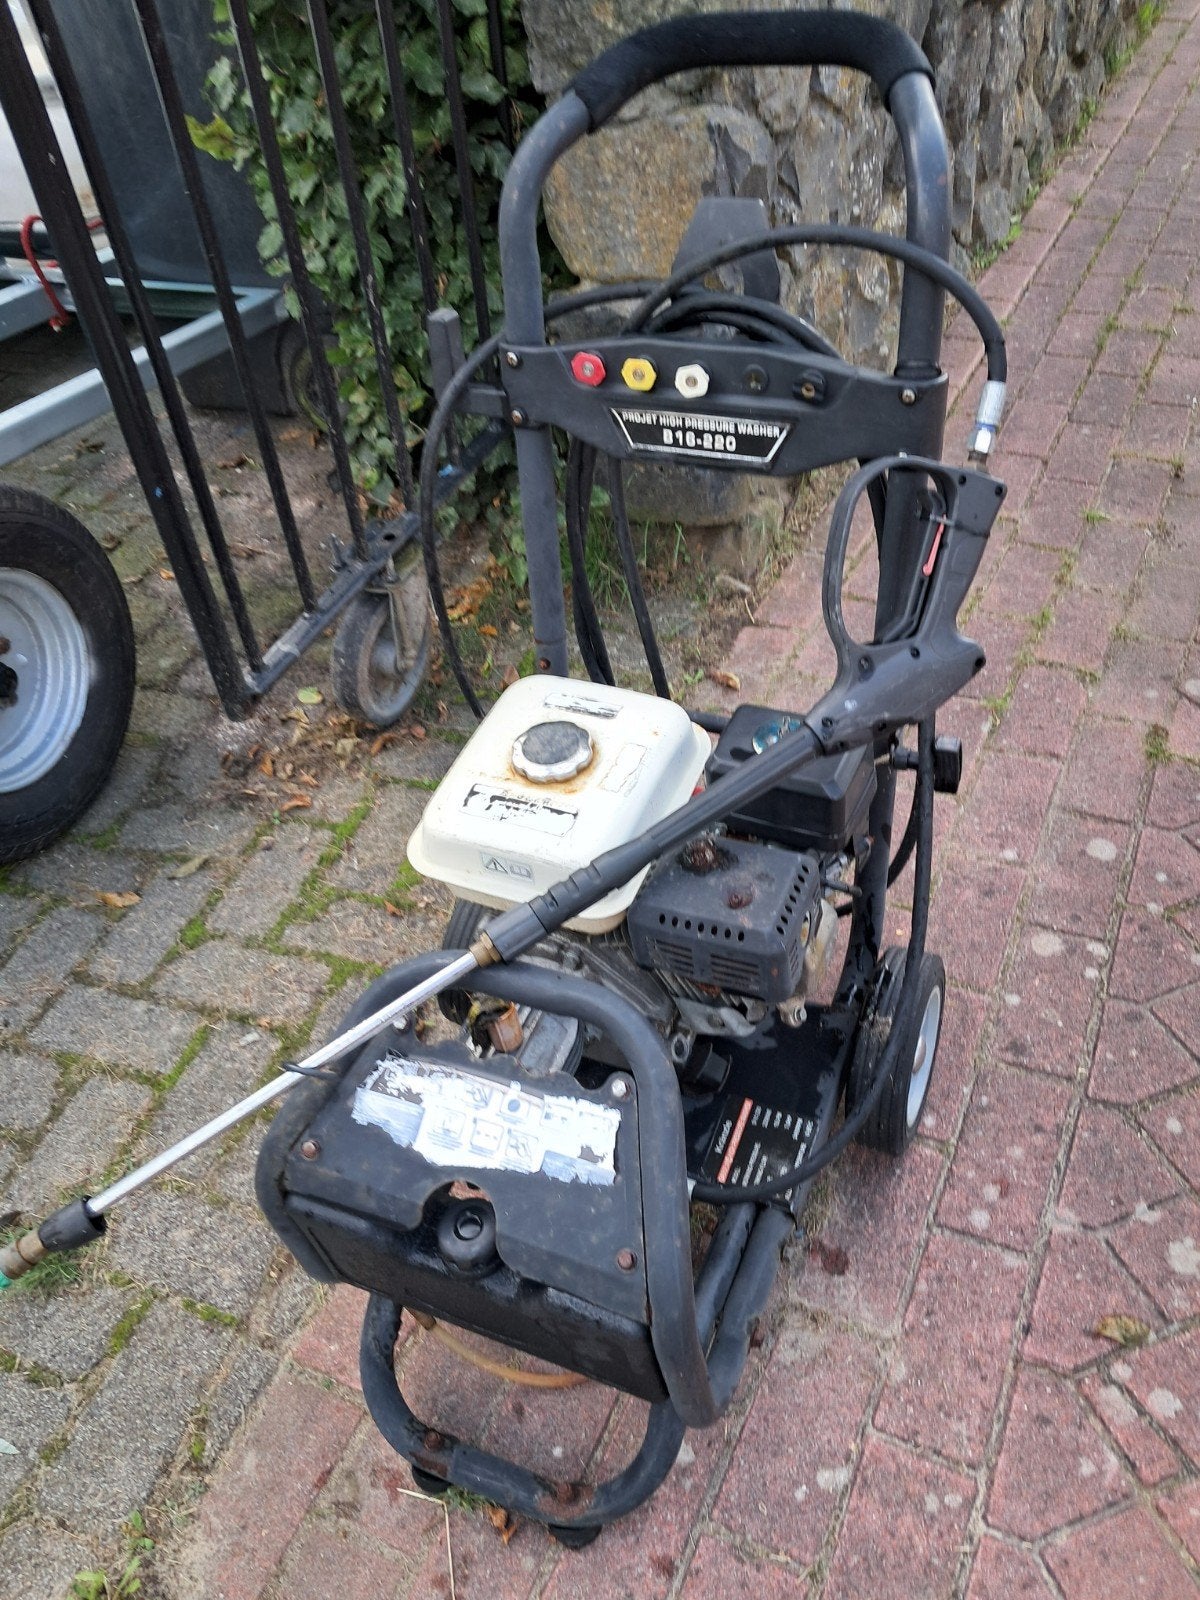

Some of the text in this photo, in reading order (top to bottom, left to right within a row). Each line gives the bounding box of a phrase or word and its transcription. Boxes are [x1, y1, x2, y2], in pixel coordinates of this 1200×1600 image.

[659, 414, 683, 429] HIGH
[685, 417, 736, 435] PRESSURE
[737, 422, 780, 439] WASHER
